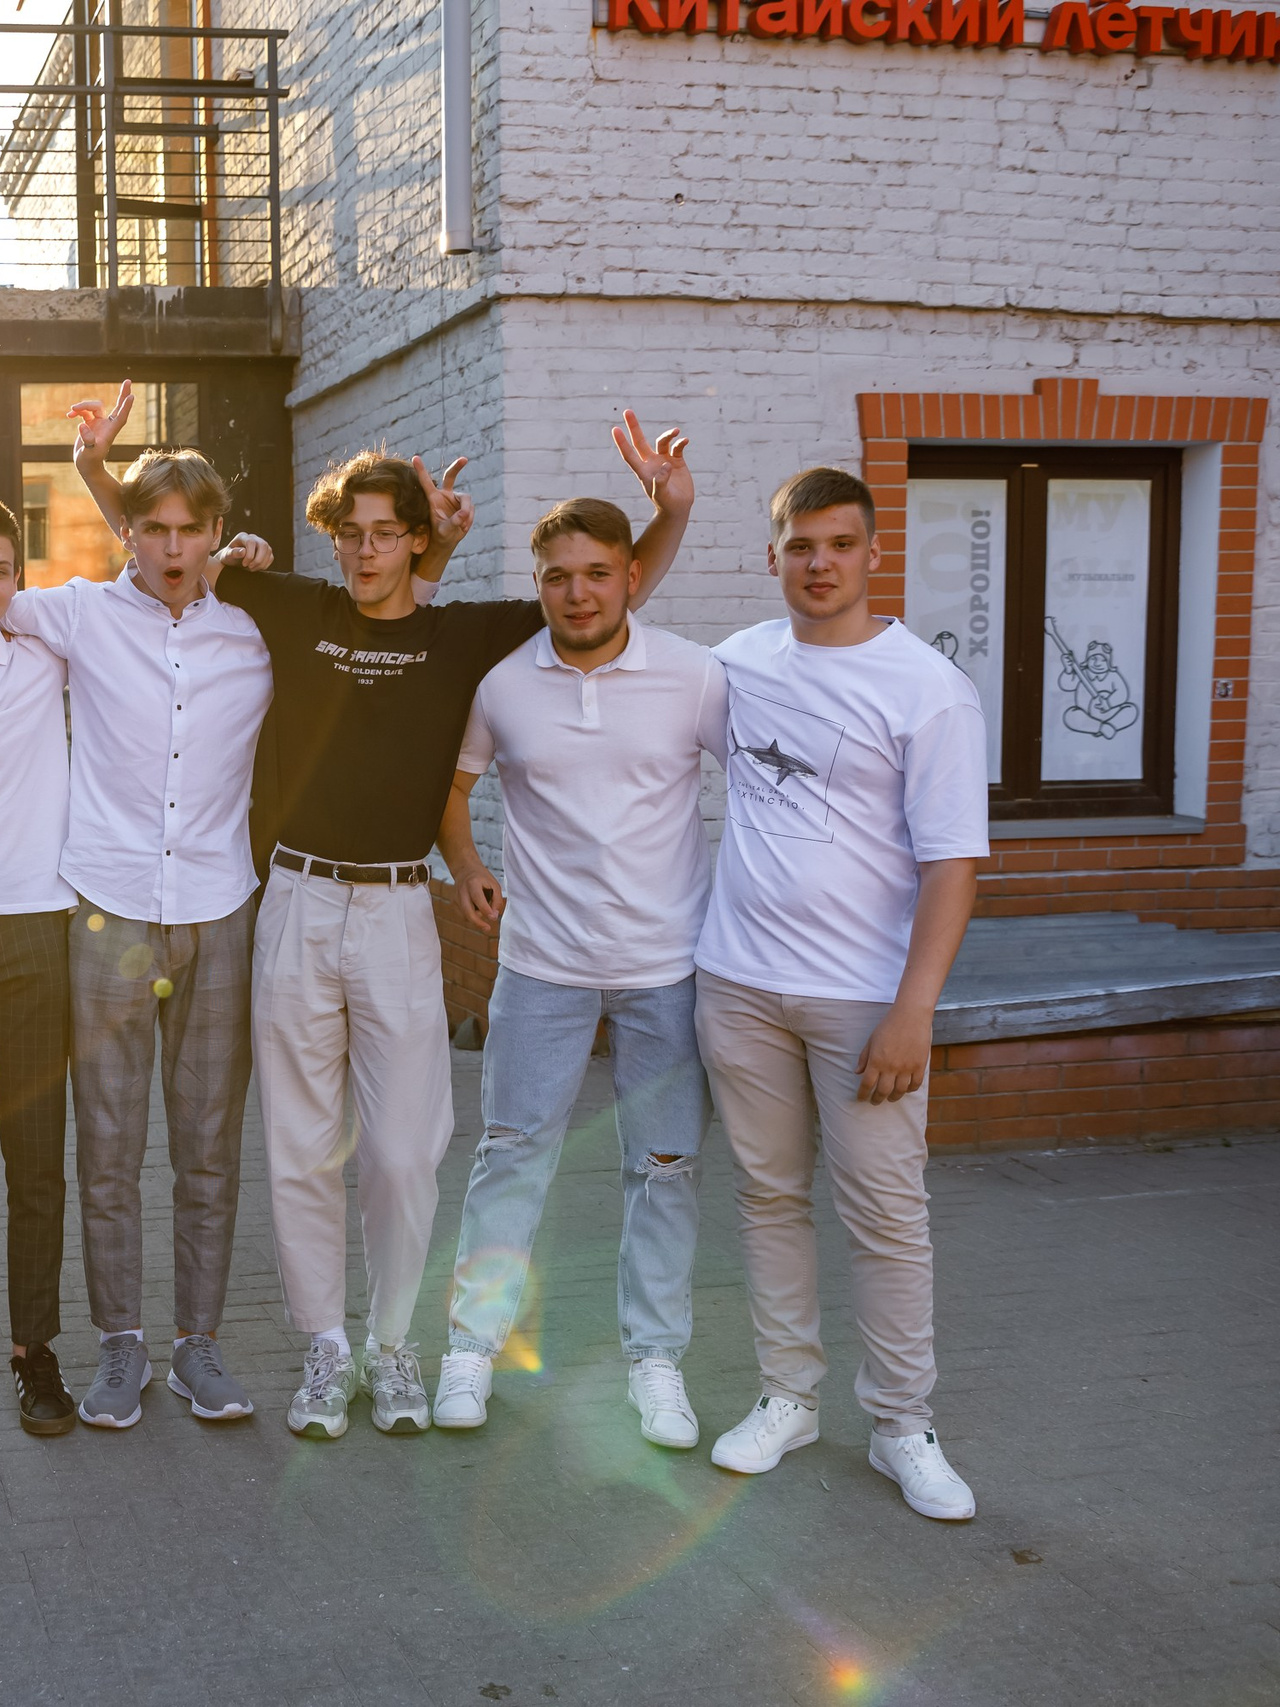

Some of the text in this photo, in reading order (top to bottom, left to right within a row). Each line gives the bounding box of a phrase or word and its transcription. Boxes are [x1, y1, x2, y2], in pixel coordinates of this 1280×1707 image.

[969, 508, 991, 658] ХОРОШО!
[1067, 572, 1136, 582] МУЗЫКАЛЬНО
[314, 639, 349, 659] SAN
[333, 662, 351, 673] THE
[737, 790, 805, 810] XTINCTIO
